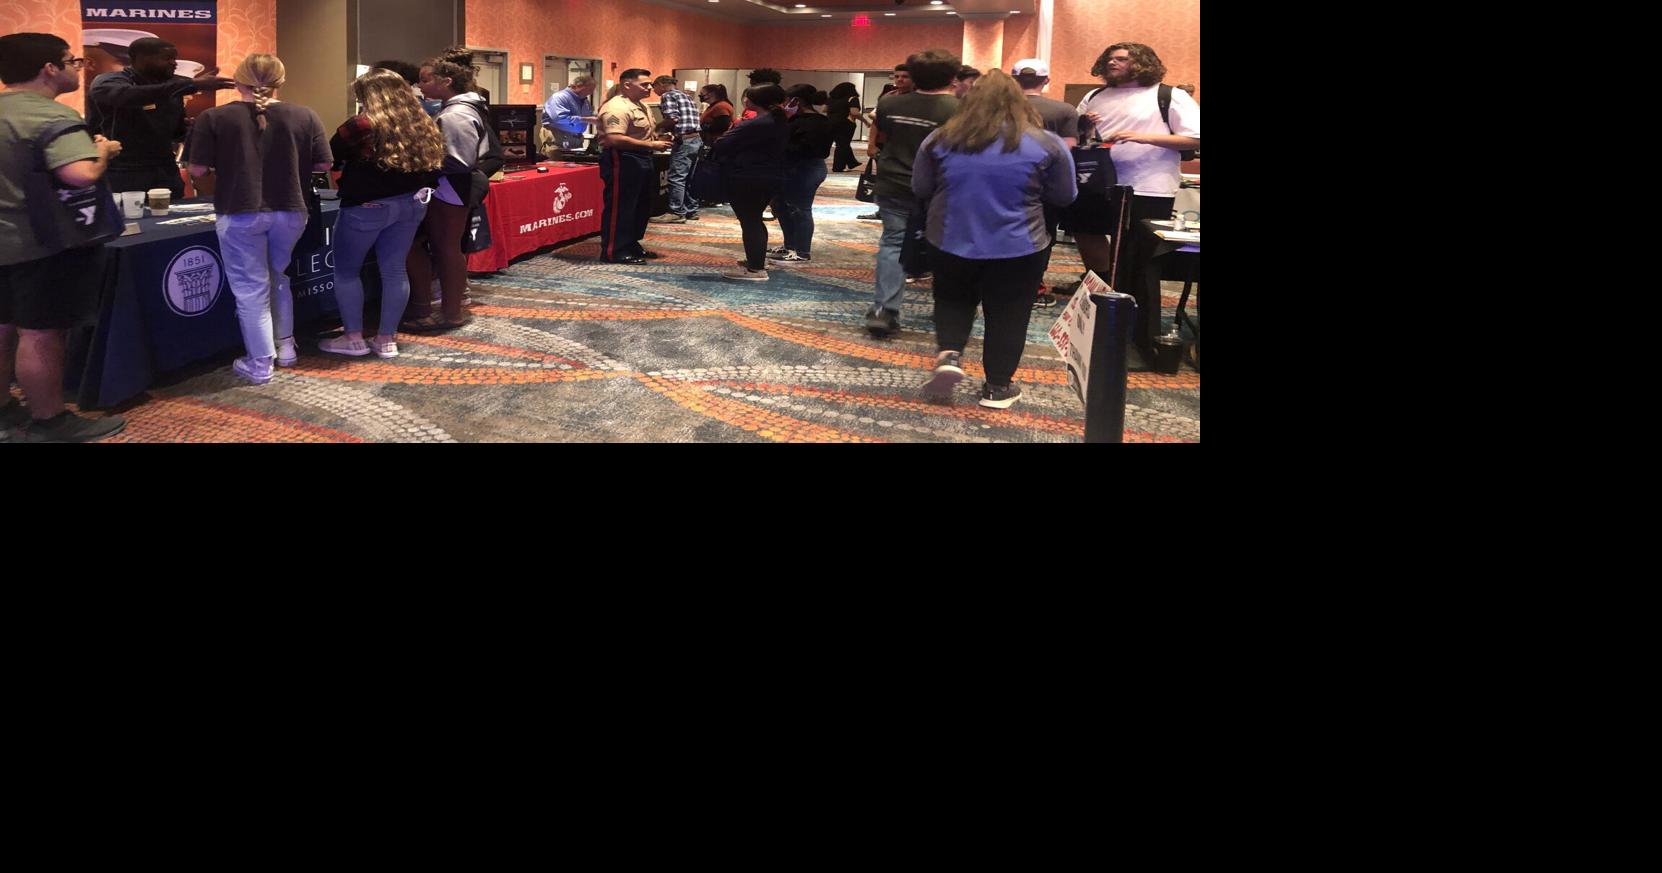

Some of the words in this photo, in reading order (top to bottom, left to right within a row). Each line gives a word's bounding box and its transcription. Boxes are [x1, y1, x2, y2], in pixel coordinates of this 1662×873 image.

[86, 8, 212, 19] MARINES
[519, 209, 594, 234] MARINES.COM
[183, 255, 205, 267] 1851
